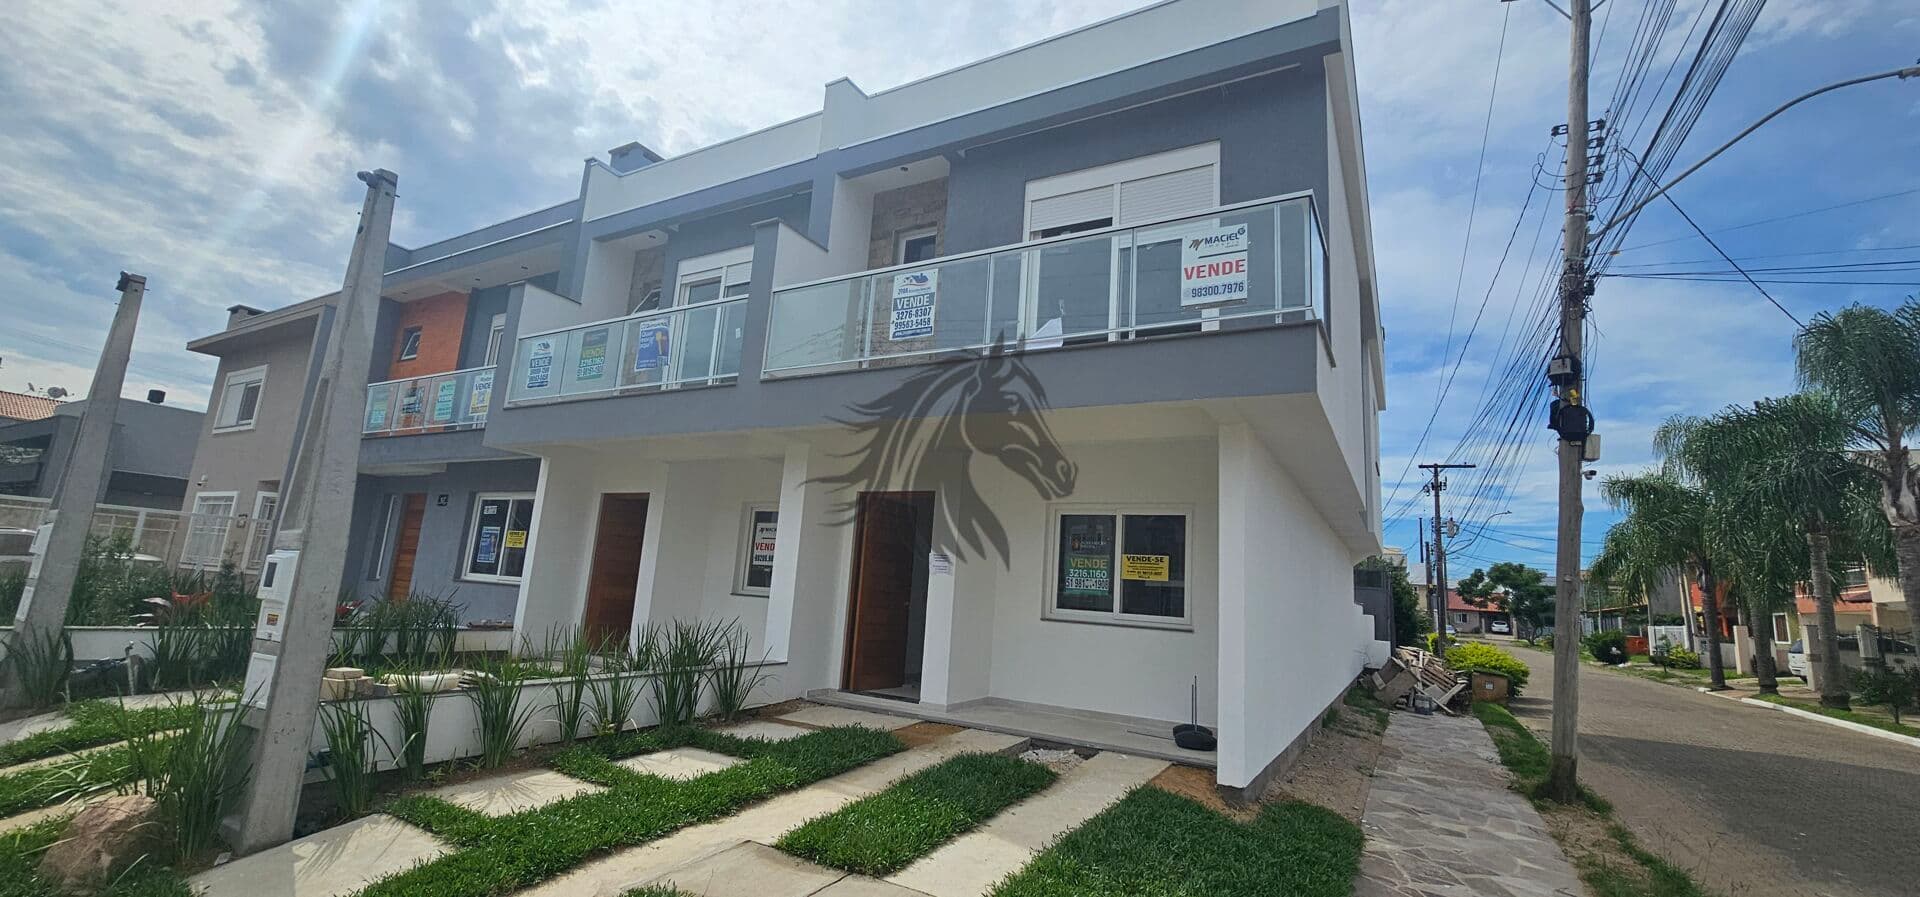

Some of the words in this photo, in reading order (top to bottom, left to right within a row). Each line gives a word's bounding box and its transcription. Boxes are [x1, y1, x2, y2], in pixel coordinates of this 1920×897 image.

[1204, 233, 1240, 246] MACIEL
[1184, 259, 1246, 281] VENDE
[1191, 282, 1244, 298] 98300.7976
[896, 294, 930, 310] VENDE
[895, 307, 932, 321] 3276-8307
[531, 356, 551, 368] VENDE
[475, 381, 492, 391] VENDE
[755, 542, 775, 551] VEND
[1070, 558, 1107, 569] VENDE
[1126, 555, 1165, 563] VENDE-SE
[1069, 569, 1107, 578] 3216.1160
